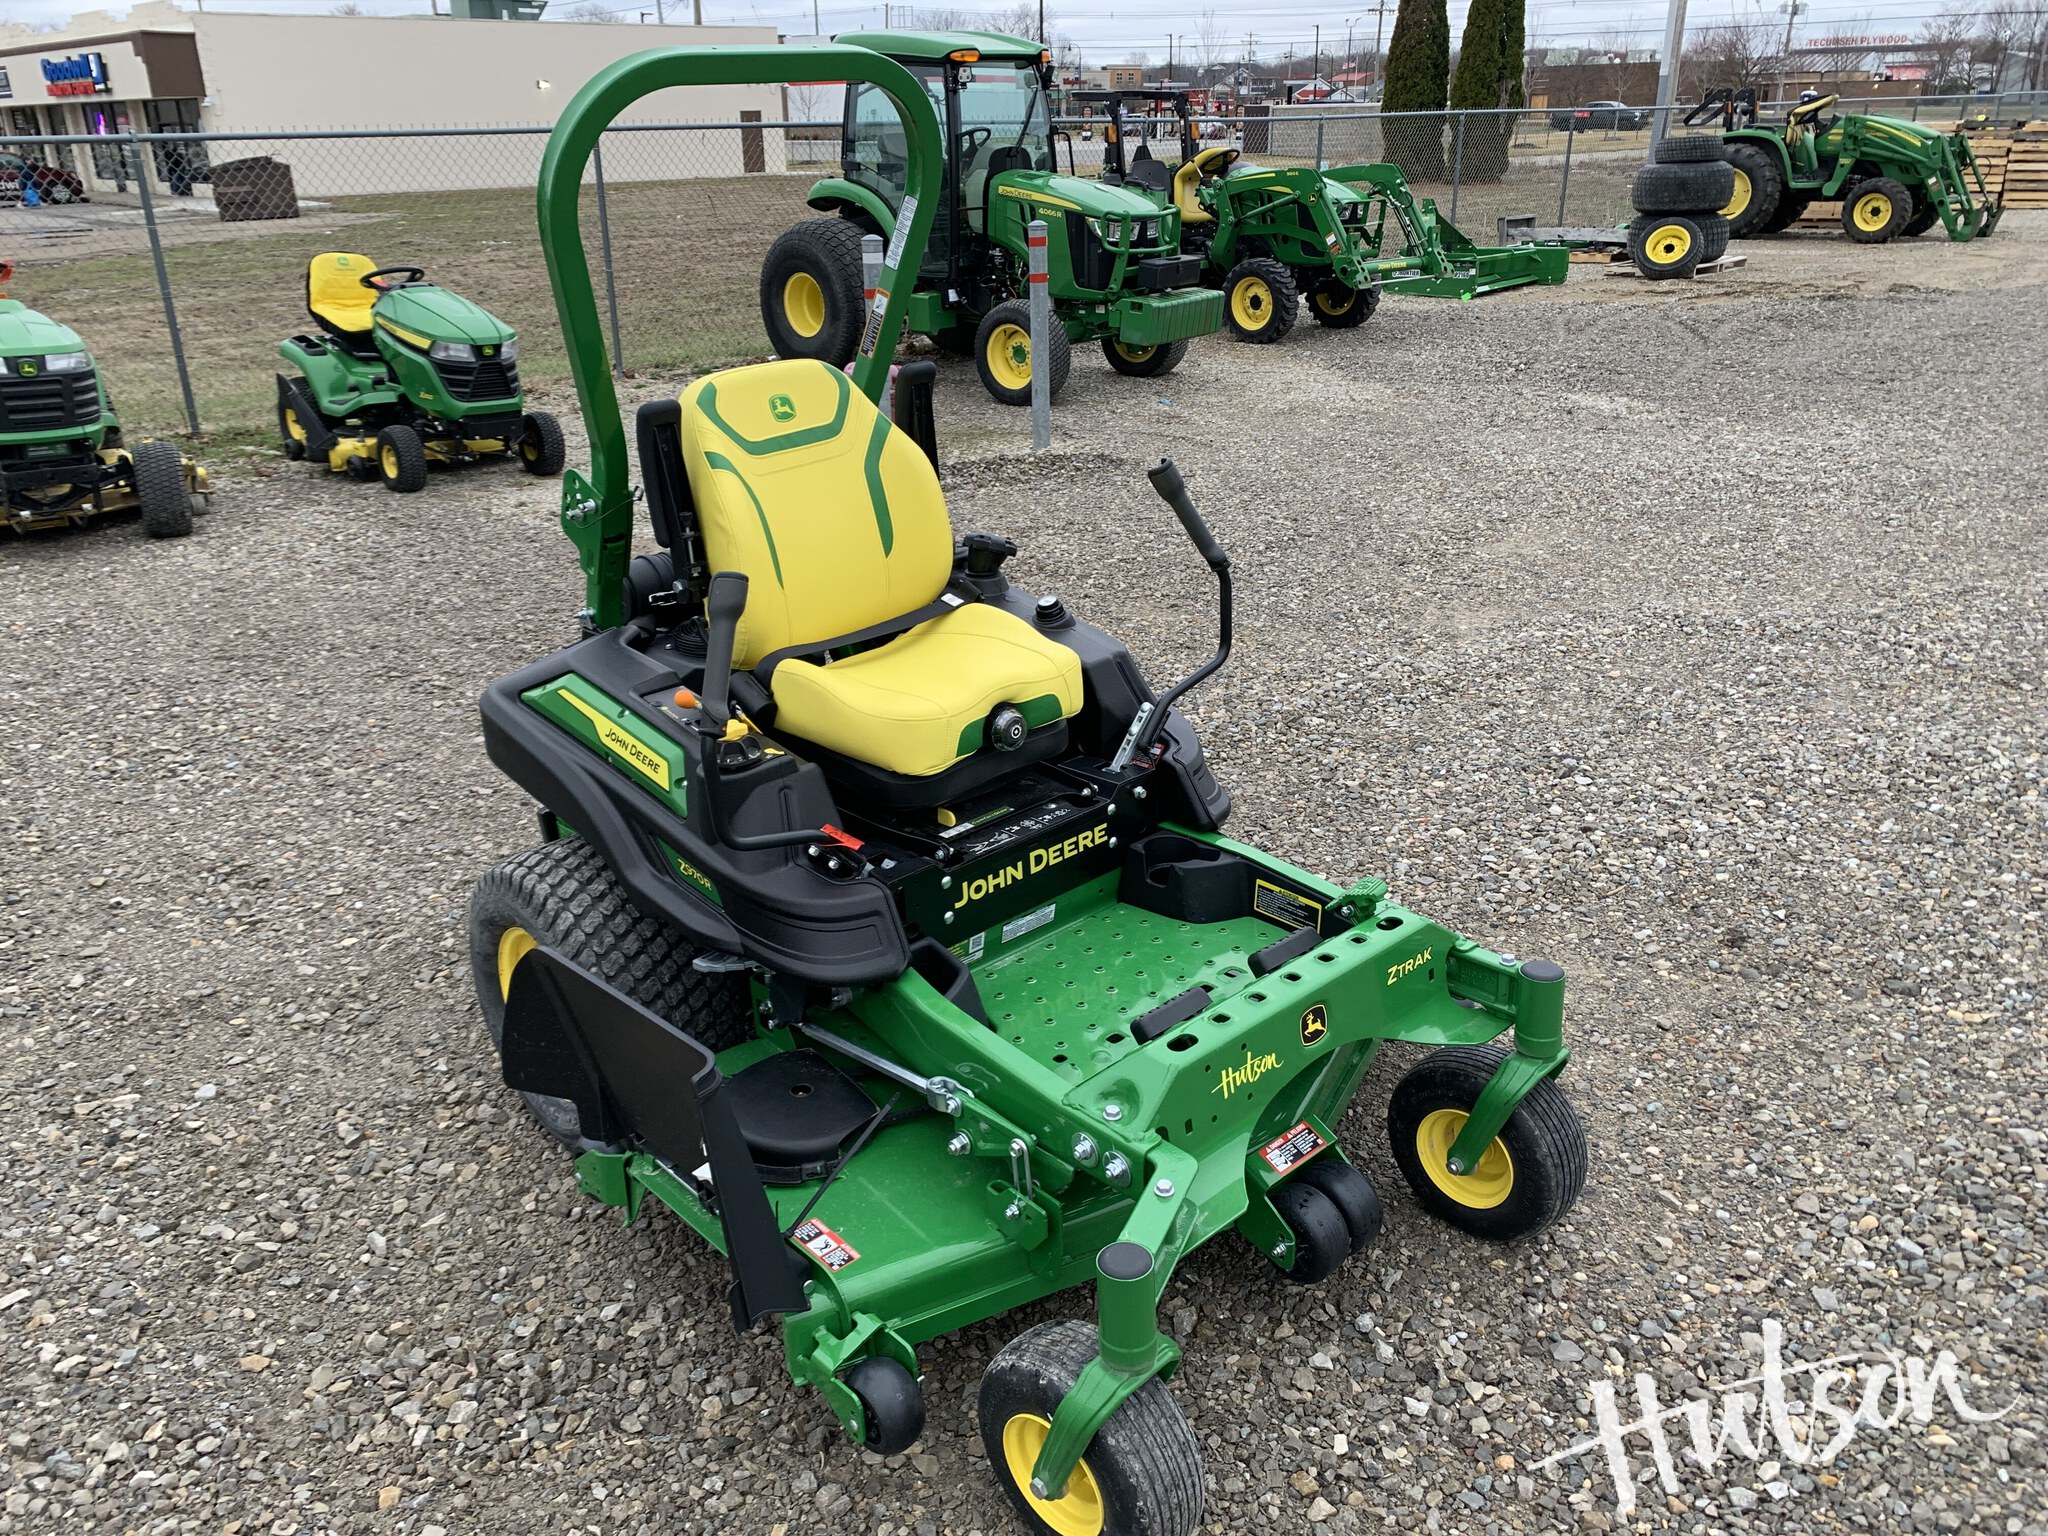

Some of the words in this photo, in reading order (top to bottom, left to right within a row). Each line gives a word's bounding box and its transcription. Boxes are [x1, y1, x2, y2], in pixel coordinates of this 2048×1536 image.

[1808, 37, 1857, 48] TECUMSEH
[1860, 35, 1908, 45] PLYWOOD
[40, 53, 92, 82] Goodwill
[1001, 187, 1014, 197] JOHN
[1015, 189, 1033, 199] DEERE
[1378, 262, 1391, 270] JOHN
[1391, 261, 1407, 270] DEERE
[605, 728, 629, 751] JOHN
[629, 744, 660, 774] DEERE
[677, 858, 712, 891] Z970R
[954, 860, 1024, 909] JOHN
[1029, 822, 1108, 875] DEERE
[1387, 946, 1432, 986] ZTRAK
[1211, 1051, 1285, 1100] Hutson
